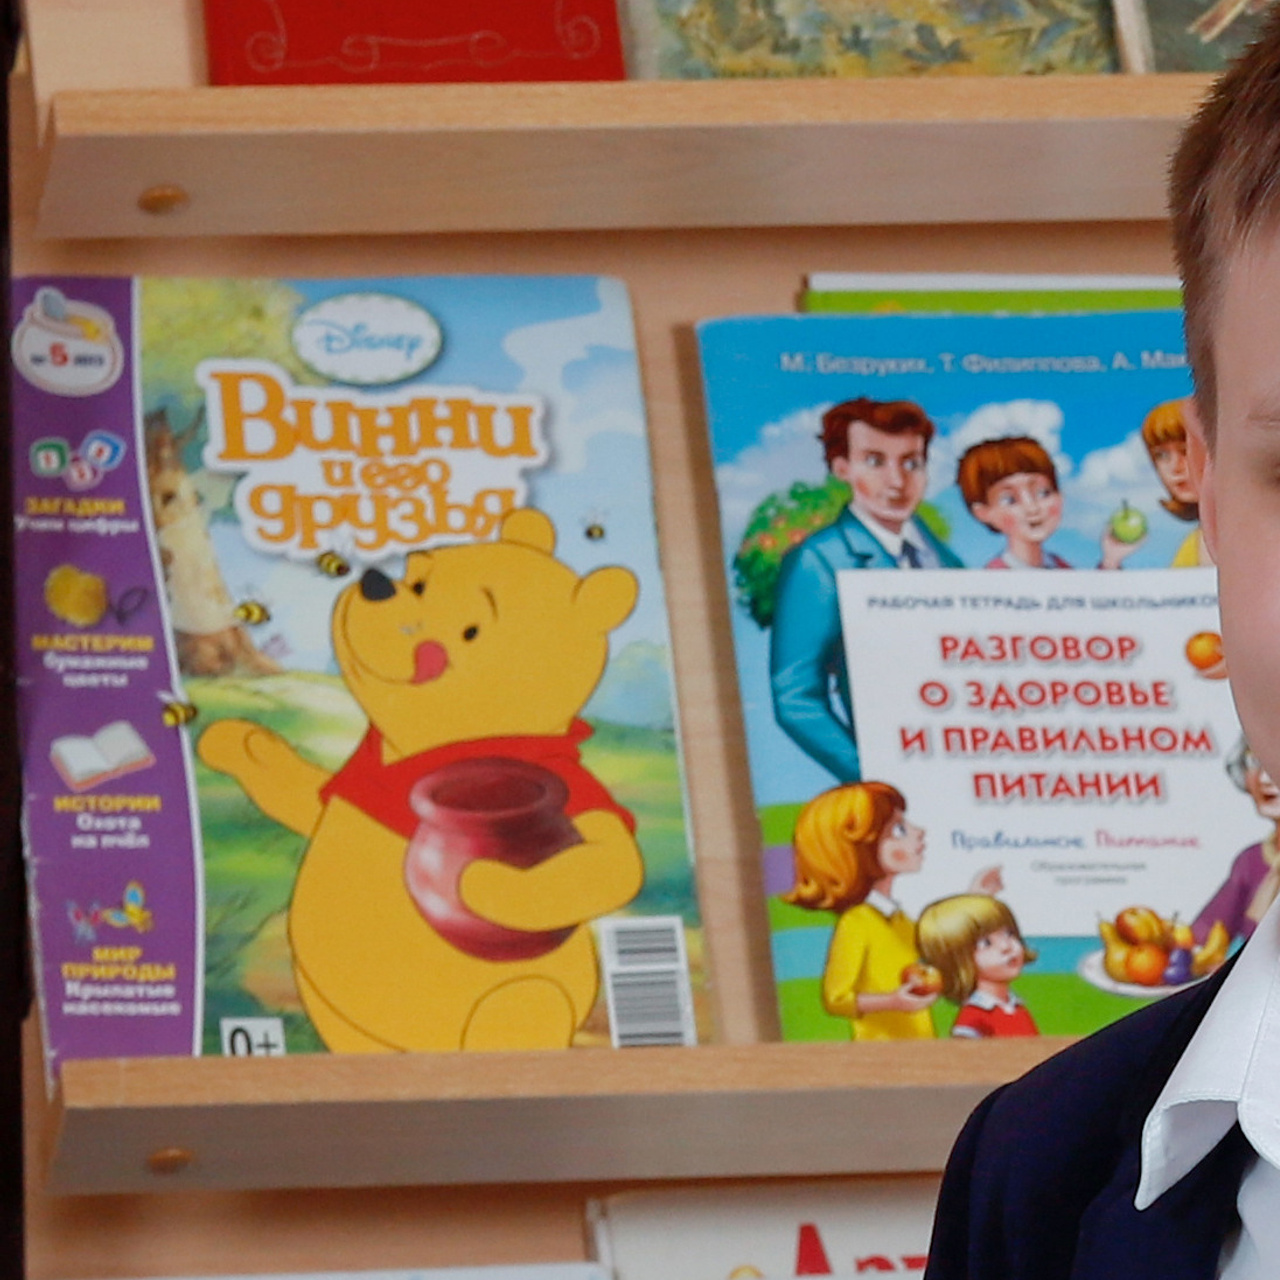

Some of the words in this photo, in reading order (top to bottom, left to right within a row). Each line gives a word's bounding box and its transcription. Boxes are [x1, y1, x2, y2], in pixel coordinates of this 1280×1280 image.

[309, 320, 425, 359] Disney
[209, 371, 540, 463] Винни
[320, 459, 352, 487] и
[360, 456, 451, 490] его
[26, 496, 126, 517] ЗАГАДКИ
[247, 482, 518, 552] друзья
[867, 597, 954, 611] РАБОЧАЯ
[960, 596, 1042, 612] ТЕТРАДЬ
[1046, 596, 1087, 611] ДЛЯ
[31, 634, 155, 652] МАСТЕРИМ
[939, 635, 1139, 663] РАЗГОВОР
[918, 680, 951, 707] О
[965, 681, 1171, 711] ЗДОРОВЬЕ
[900, 727, 928, 753] И
[942, 726, 1213, 754] ПРАВИЛЬНОМ
[972, 773, 1162, 799] ПИТАНИИ
[53, 795, 162, 813] ИСТОРИИ
[952, 829, 1086, 852] Правильное
[1095, 827, 1202, 849] Питание
[61, 962, 177, 982] ПРИРОДЫ
[64, 980, 176, 1000] Крылатые
